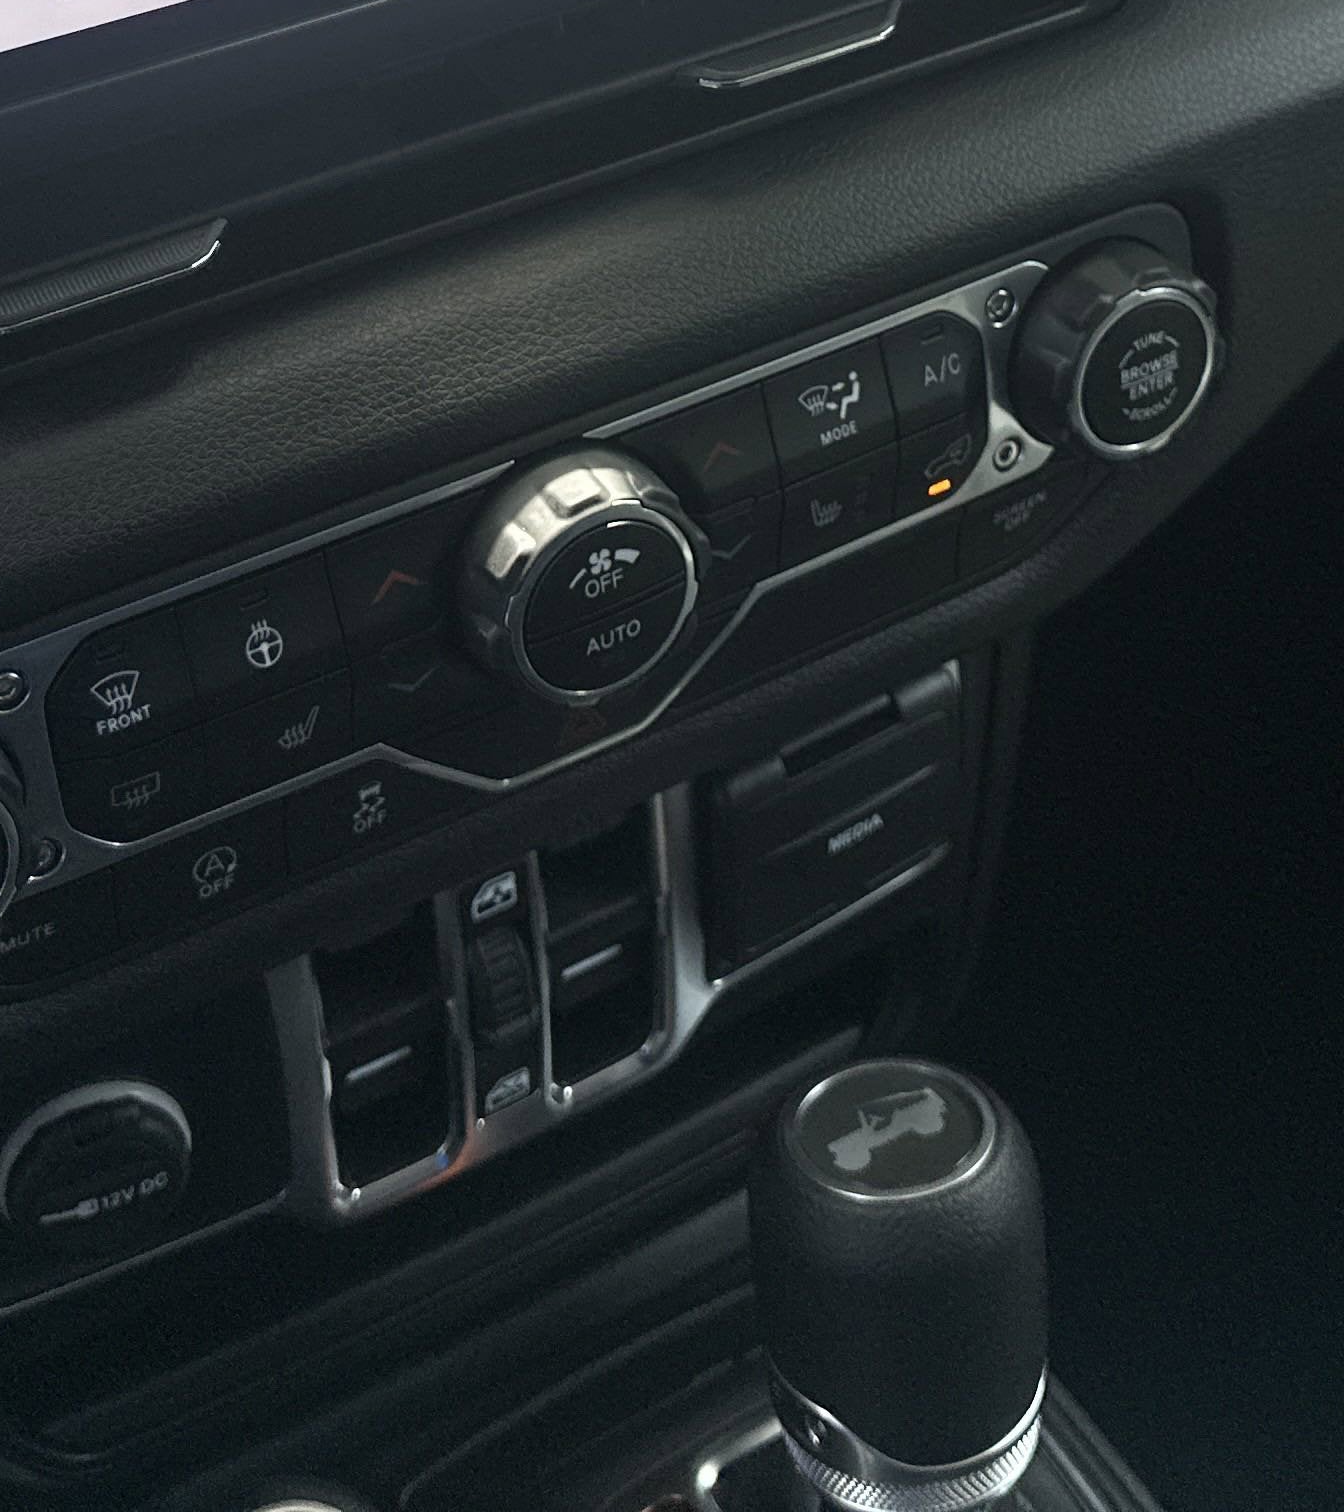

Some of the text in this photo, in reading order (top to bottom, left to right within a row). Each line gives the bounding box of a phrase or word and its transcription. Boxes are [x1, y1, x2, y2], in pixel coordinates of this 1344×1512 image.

[1133, 331, 1165, 350] TUNE
[923, 353, 961, 386] A/C
[1120, 350, 1178, 384] BROWSE
[1129, 371, 1174, 400] ENTER
[819, 420, 858, 446] MODE
[584, 568, 625, 599] OFF
[586, 619, 642, 656] AUTO
[96, 704, 151, 735] FRONT
[353, 809, 387, 833] OFF
[199, 875, 235, 899] OFF
[0, 922, 57, 954] MUTE
